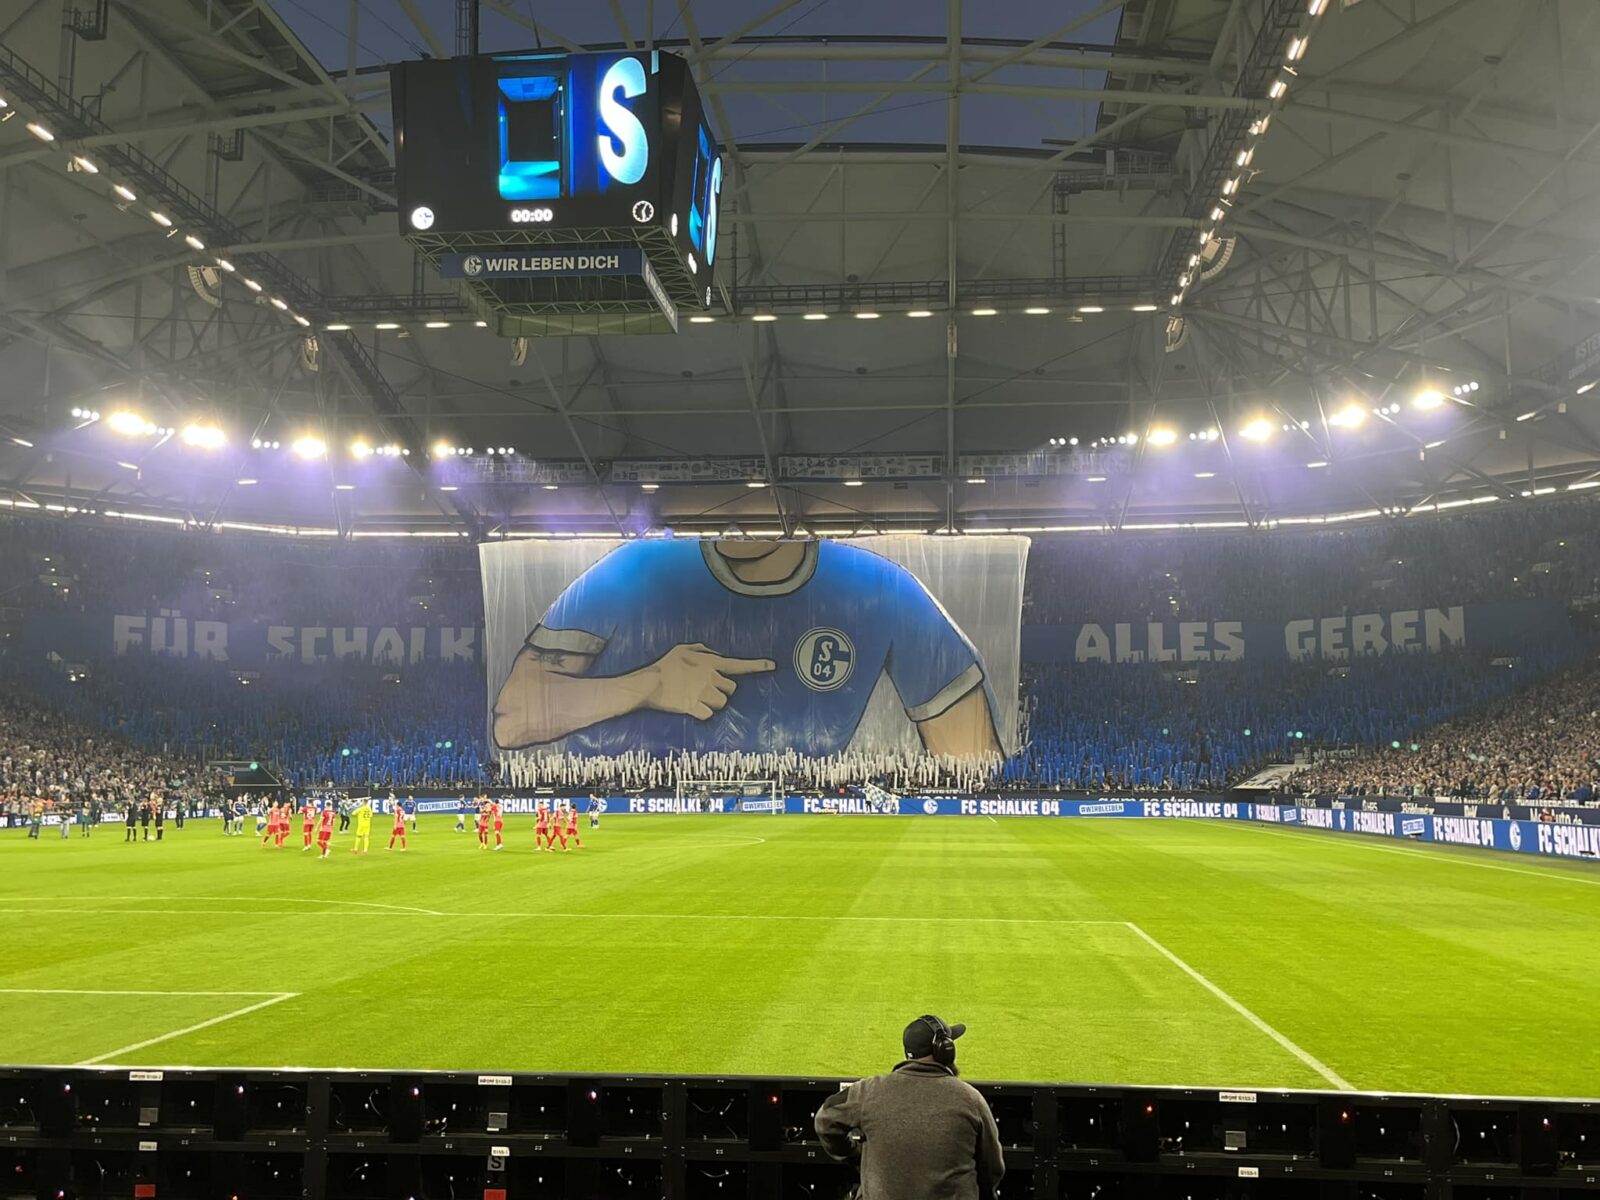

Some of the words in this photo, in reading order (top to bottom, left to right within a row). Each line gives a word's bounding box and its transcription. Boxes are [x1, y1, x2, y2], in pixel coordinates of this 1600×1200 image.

[511, 208, 554, 223] 00:00
[486, 258, 518, 271] WIR
[521, 256, 575, 271] LEBEN
[577, 255, 619, 269] DICH
[113, 609, 230, 660] FÜR
[1075, 621, 1245, 663] ALLES
[1284, 606, 1466, 662] GEBEN
[629, 799, 645, 812] FC
[803, 799, 820, 813] FC
[961, 800, 977, 814] FC
[980, 800, 1038, 815] SCHALKE
[1041, 800, 1060, 815] 04
[1144, 802, 1160, 816] FC
[1163, 802, 1221, 818] SCHALKE
[1223, 803, 1238, 818] 04
[1433, 816, 1444, 841] FC
[1444, 817, 1480, 845] SCHALKE
[1480, 820, 1494, 847] 04
[1538, 824, 1552, 853] FC
